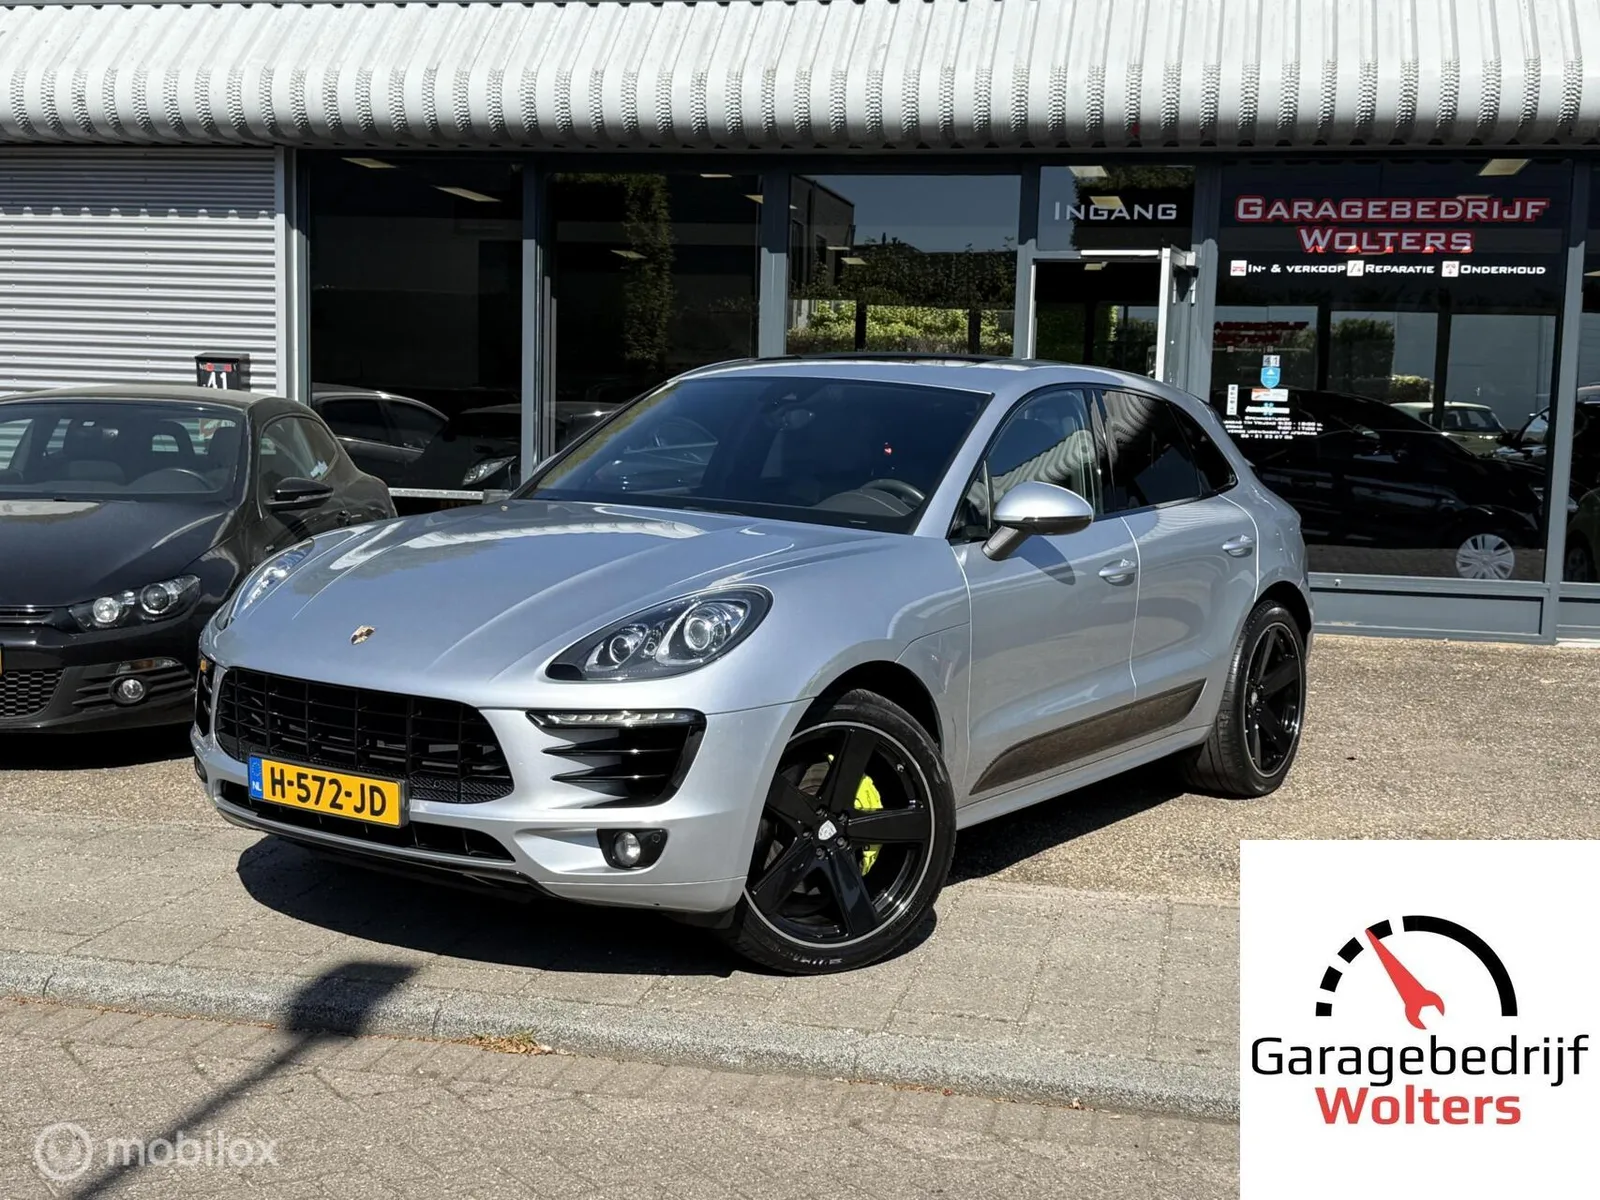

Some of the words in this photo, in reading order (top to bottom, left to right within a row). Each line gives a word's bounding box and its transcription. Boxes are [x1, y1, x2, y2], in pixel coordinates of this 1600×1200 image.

[1054, 201, 1178, 220] INGANG
[1236, 197, 1548, 221] GARAGEBEDRIJF
[1299, 228, 1473, 252] WOLTERS
[1248, 264, 1266, 273] IN-
[1270, 264, 1281, 273] &
[1286, 264, 1346, 273] VERKOOP
[1365, 264, 1435, 274] REPARATIE
[1460, 264, 1547, 275] ONDERHOUD
[1264, 356, 1278, 366] 41
[251, 780, 262, 791] NL
[270, 766, 387, 817] H-572-JD
